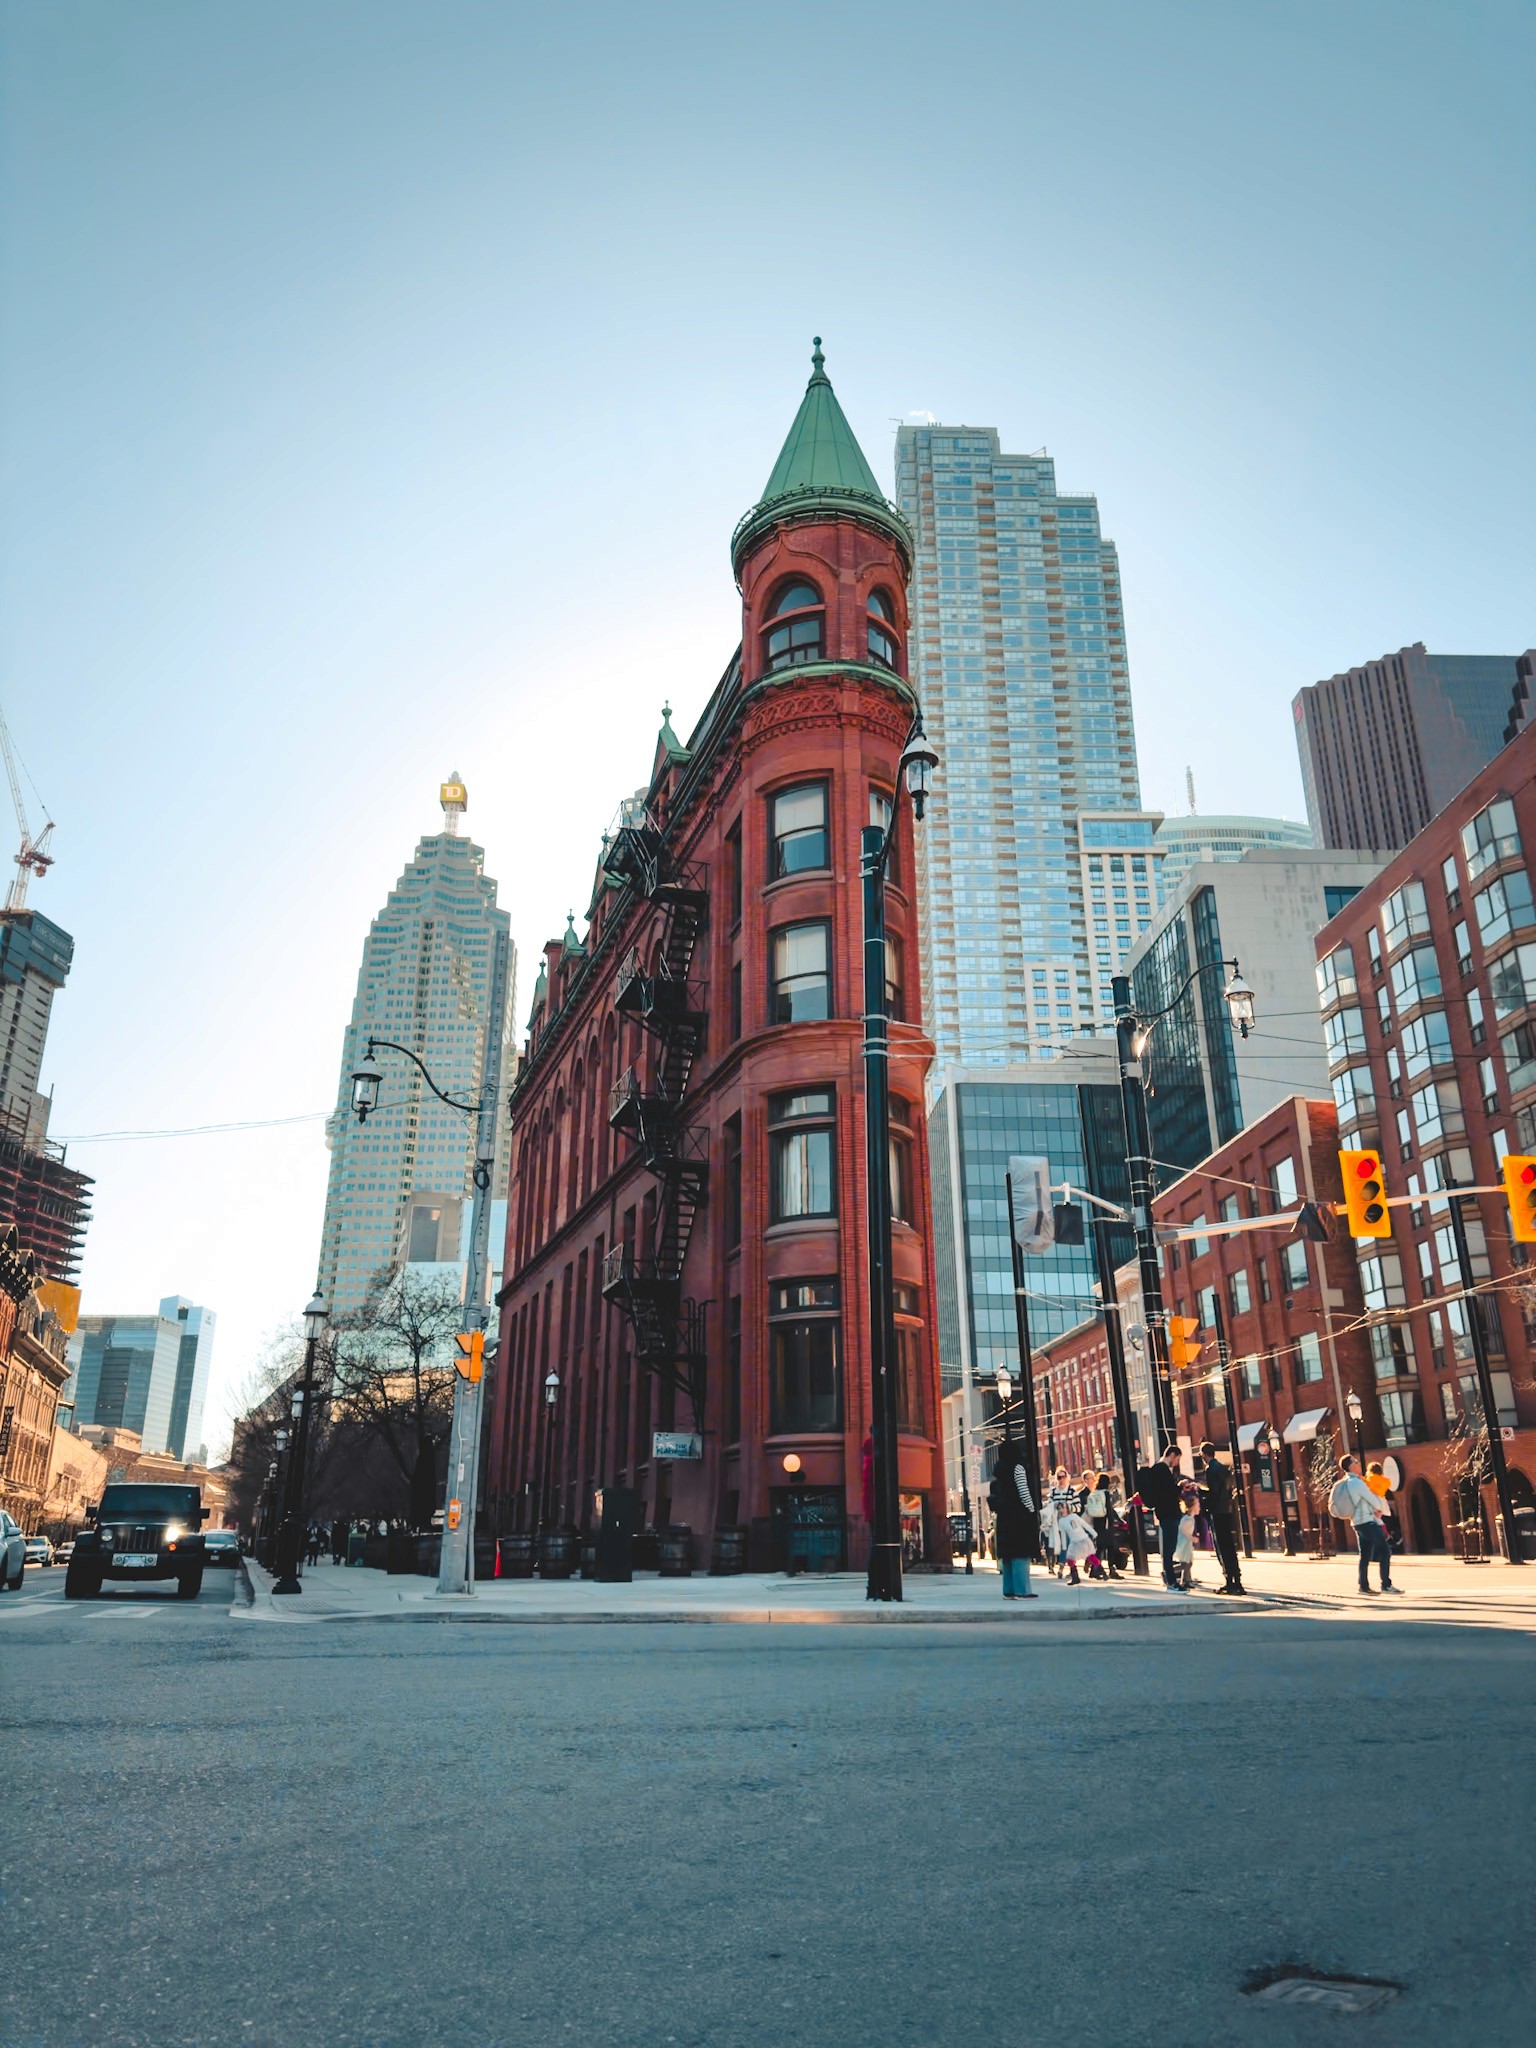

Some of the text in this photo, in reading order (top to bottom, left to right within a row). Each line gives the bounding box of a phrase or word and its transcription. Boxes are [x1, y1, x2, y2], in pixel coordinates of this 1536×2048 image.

[442, 786, 461, 798] TD
[0, 1409, 14, 1452] WINNERS
[1261, 1469, 1271, 1477] 52
